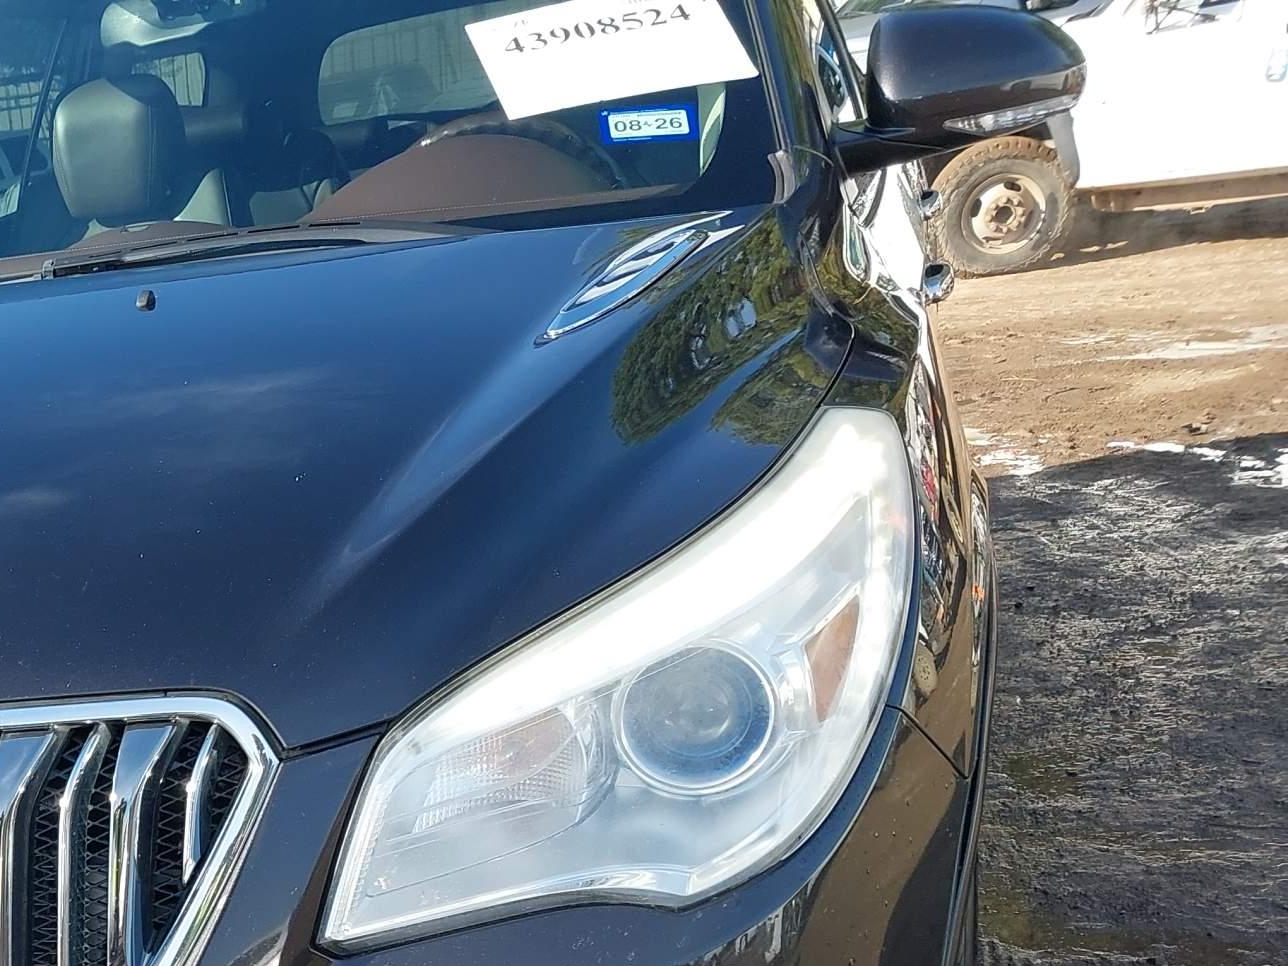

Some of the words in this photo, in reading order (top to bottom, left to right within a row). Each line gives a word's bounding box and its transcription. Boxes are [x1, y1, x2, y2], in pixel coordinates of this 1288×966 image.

[504, 4, 691, 53] 43908524
[614, 119, 642, 132] 08
[655, 117, 683, 130] 26
